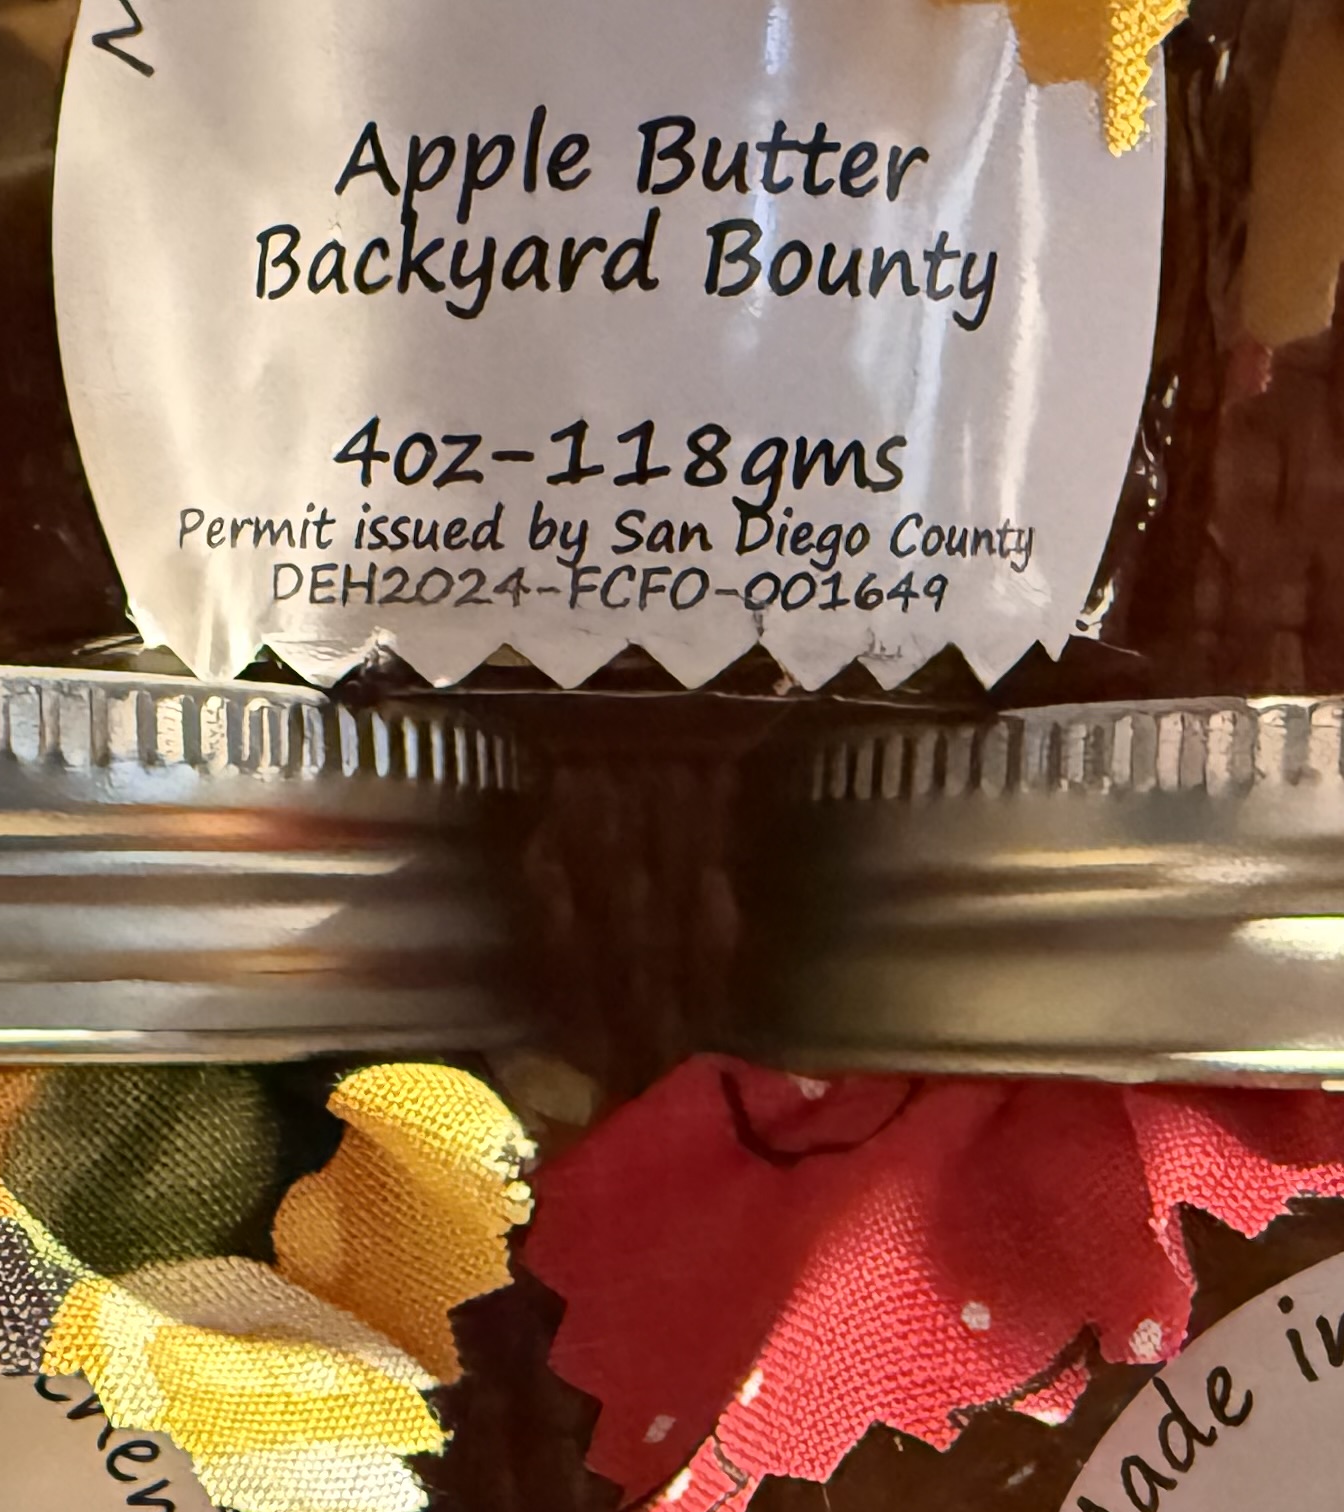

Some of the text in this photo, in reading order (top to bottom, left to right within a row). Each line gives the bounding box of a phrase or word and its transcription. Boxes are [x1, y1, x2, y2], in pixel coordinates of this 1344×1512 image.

[335, 105, 929, 223] Apple Butter
[255, 210, 1000, 330] Backyard Bounty
[333, 418, 905, 513] 4oz-118gms
[179, 503, 1036, 571] Permit issued by San Diego County
[270, 564, 948, 613] DEH2024-FCFO-001649
